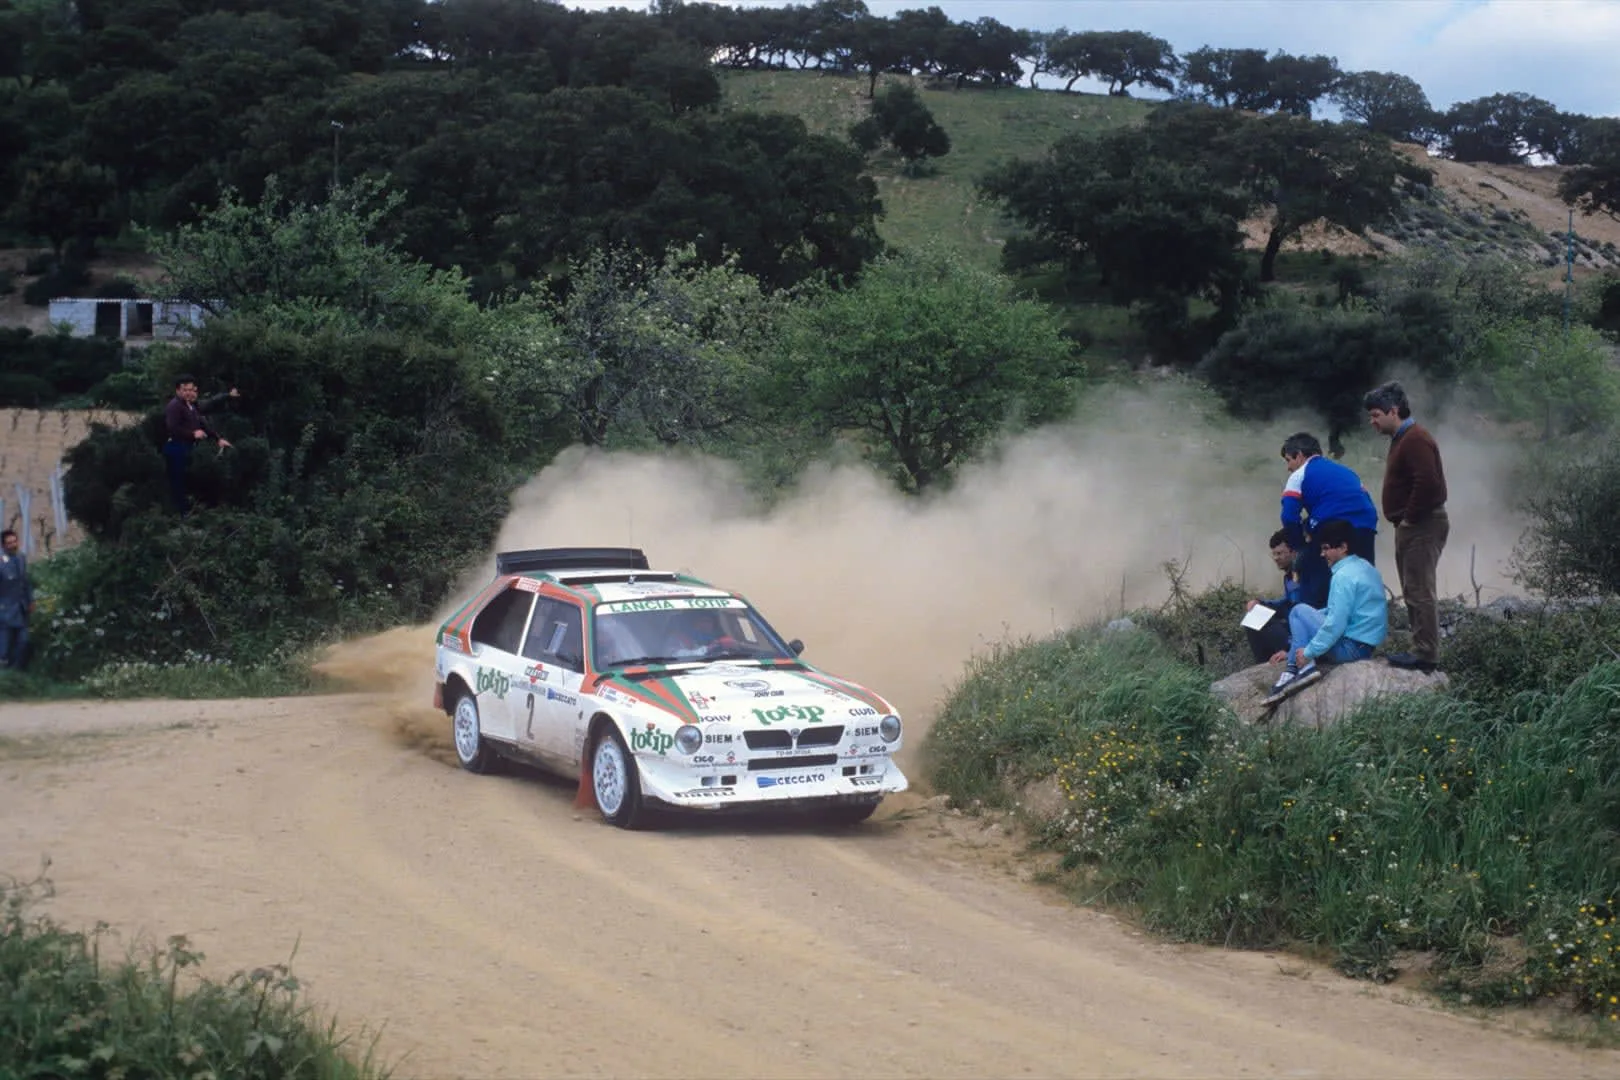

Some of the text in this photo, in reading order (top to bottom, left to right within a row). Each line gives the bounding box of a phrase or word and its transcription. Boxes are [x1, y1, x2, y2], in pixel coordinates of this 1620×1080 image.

[609, 599, 731, 613] LANCIA TOTIP
[477, 666, 510, 700] totip
[526, 692, 536, 740] 2
[751, 704, 825, 726] totip
[705, 734, 733, 744] SIEM
[855, 727, 879, 737] SIEM
[630, 727, 675, 756] totip
[777, 774, 825, 786] CECCATO
